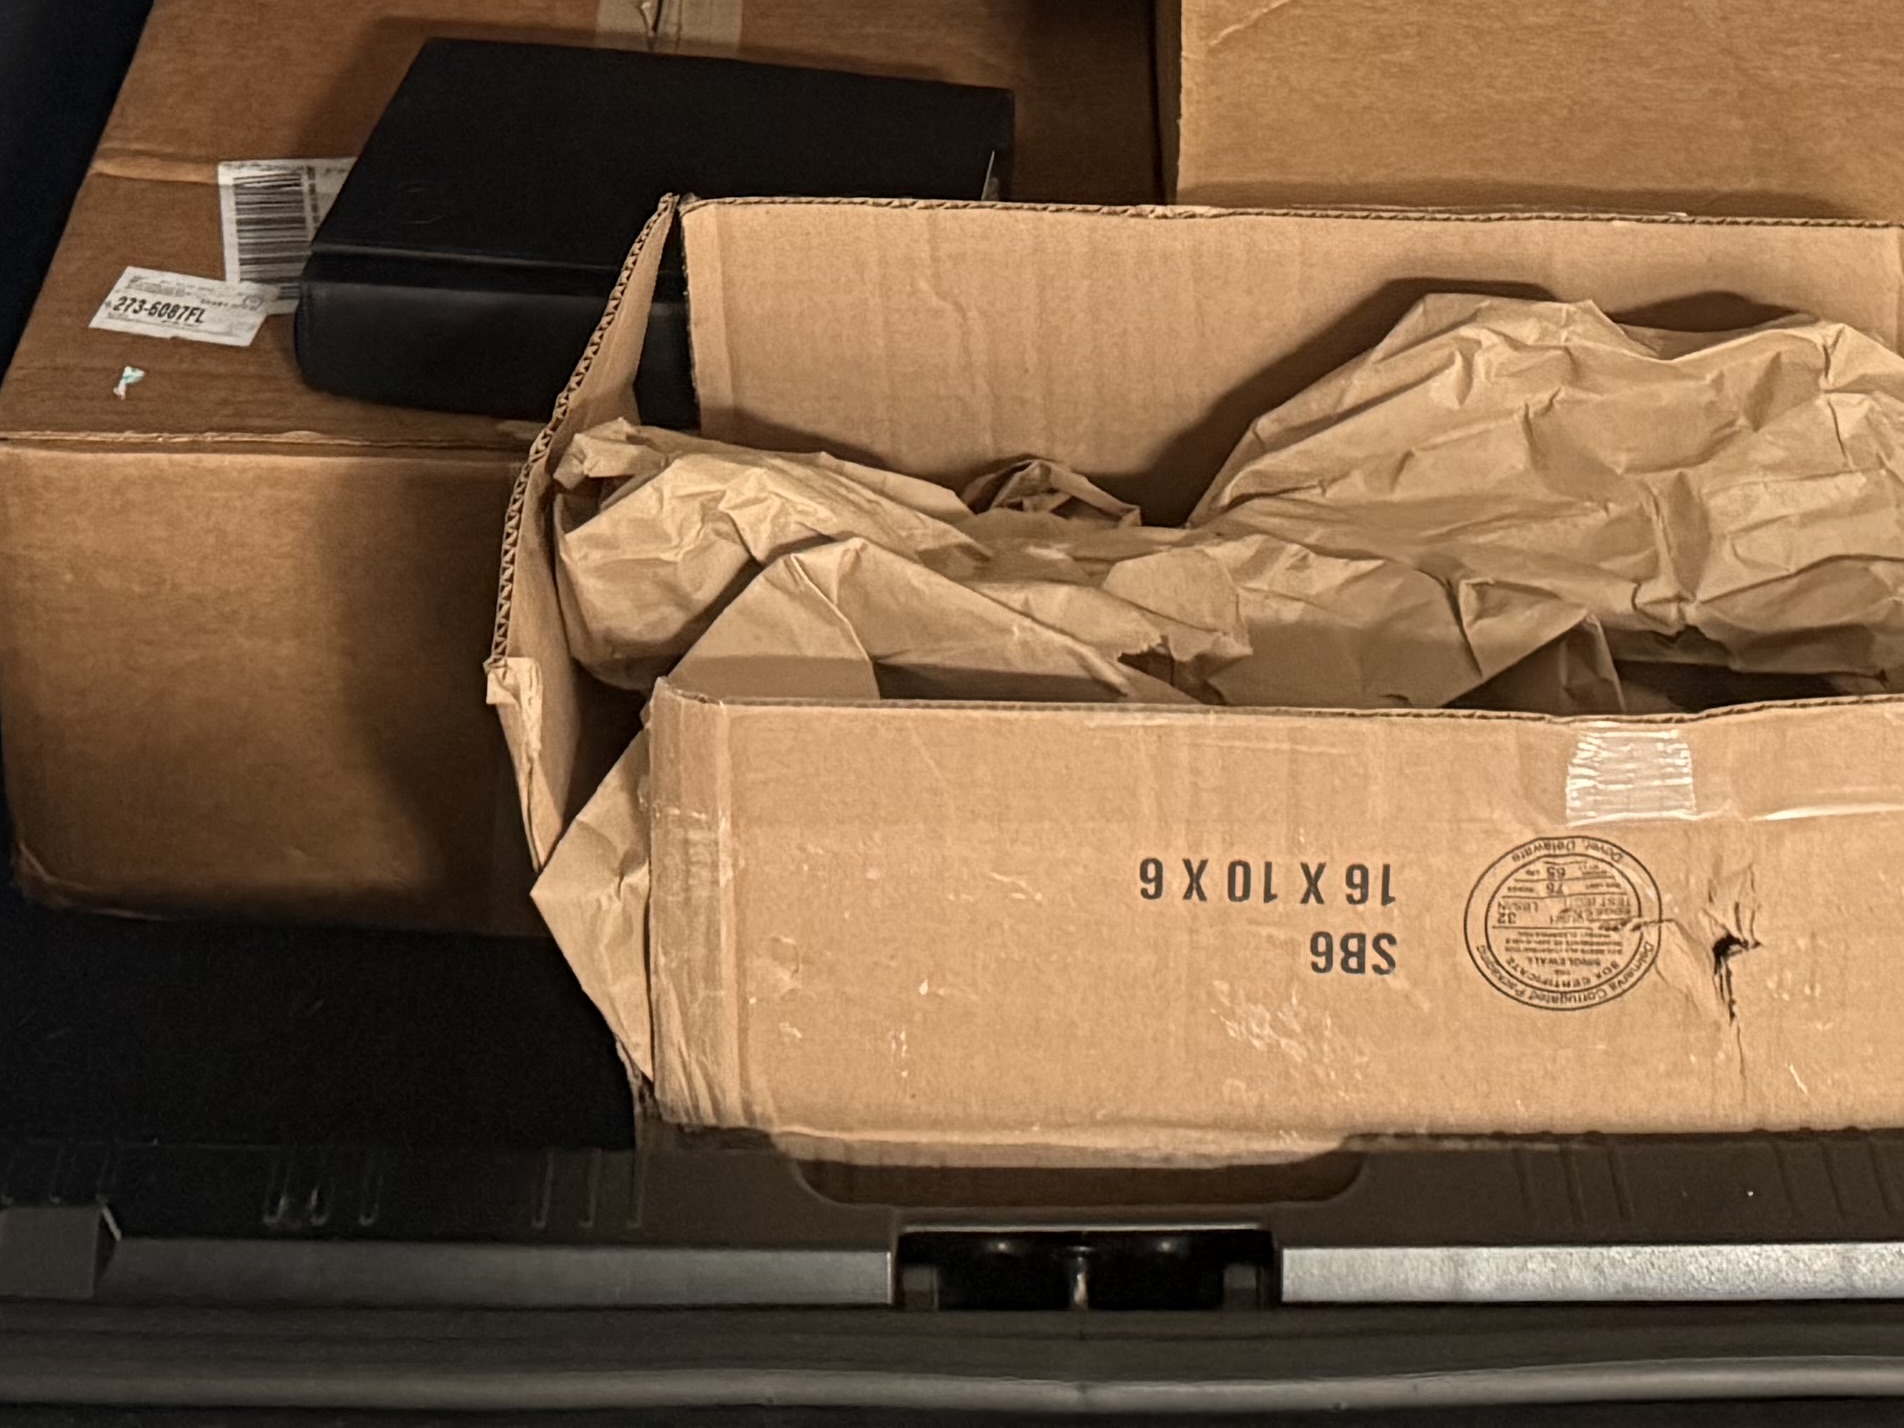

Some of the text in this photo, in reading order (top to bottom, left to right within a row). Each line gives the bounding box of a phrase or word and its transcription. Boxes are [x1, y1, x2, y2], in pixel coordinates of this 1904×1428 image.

[113, 295, 205, 325] 273-6087FL
[1512, 840, 1575, 862] Delaware
[1139, 857, 1396, 906] 16 X 10 X 6
[1497, 912, 1517, 925] 32
[1310, 931, 1397, 975] SB6
[1506, 956, 1591, 988] CERTIFICATE
[1529, 989, 1608, 1005] Corrugated
